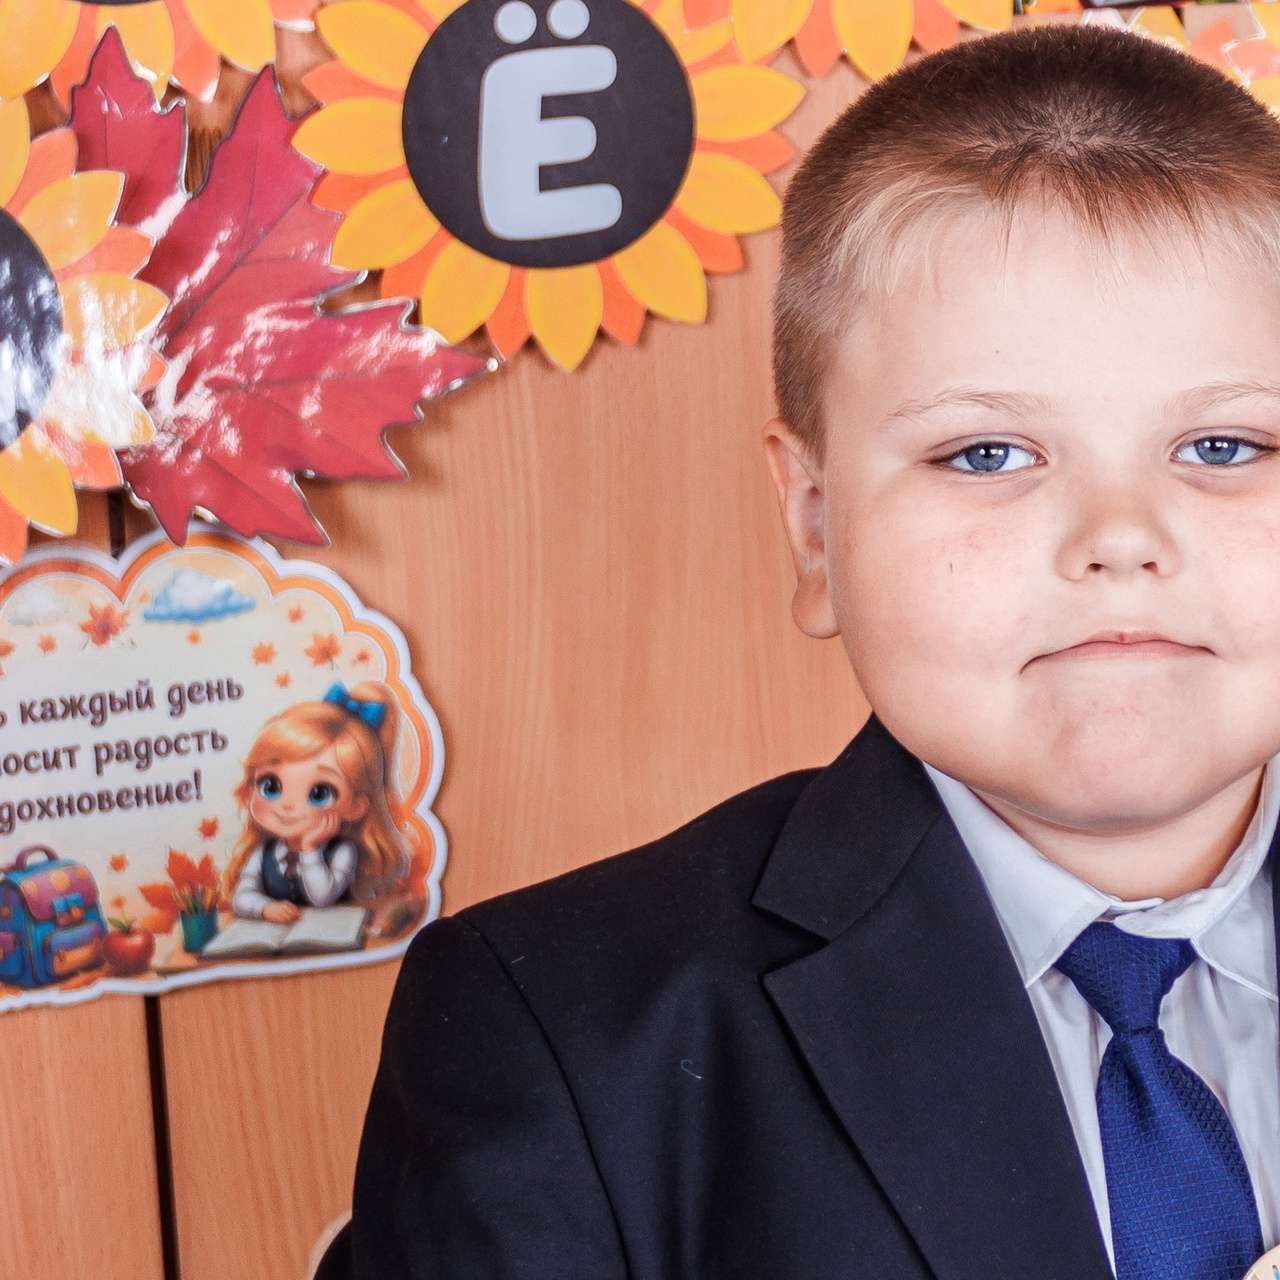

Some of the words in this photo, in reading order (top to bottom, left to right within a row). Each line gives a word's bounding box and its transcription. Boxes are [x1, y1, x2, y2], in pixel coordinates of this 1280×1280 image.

[19, 679, 156, 727] каждый
[167, 677, 244, 718] день
[0, 744, 81, 776] осит
[93, 728, 229, 776] радость
[0, 768, 203, 836] дохновение!
